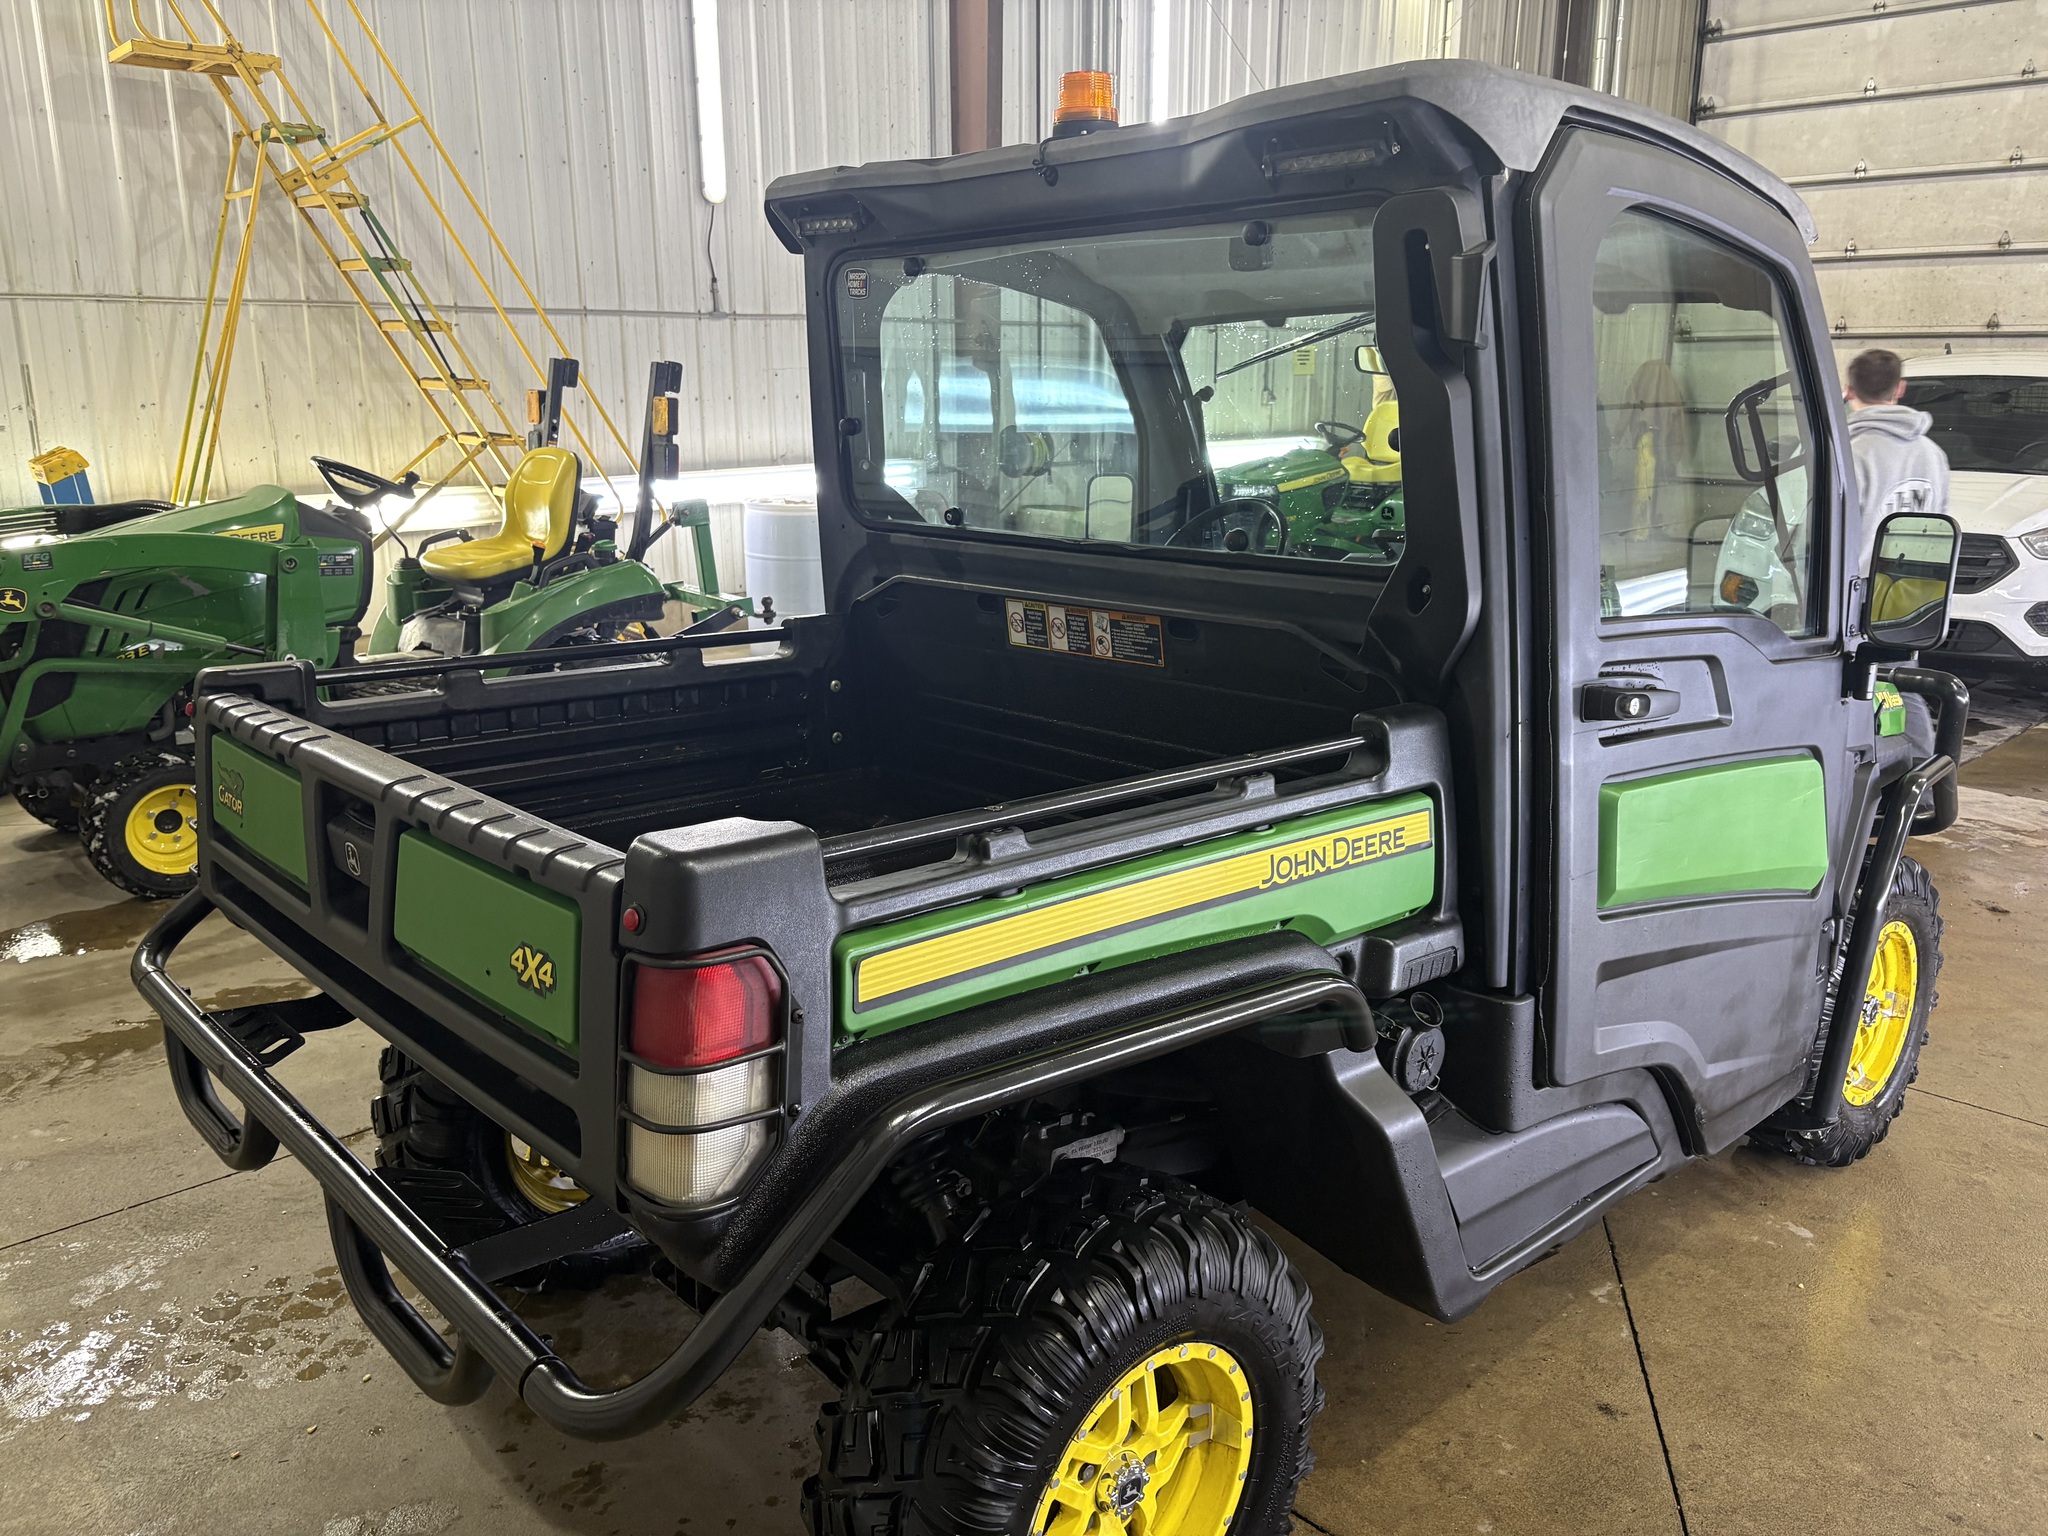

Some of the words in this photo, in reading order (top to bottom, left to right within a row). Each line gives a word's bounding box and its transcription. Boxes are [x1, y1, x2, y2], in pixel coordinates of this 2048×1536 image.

[23, 552, 50, 563] KFG
[218, 784, 243, 815] GATOR
[1262, 846, 1326, 885] JOHN
[1333, 826, 1405, 865] DEERE
